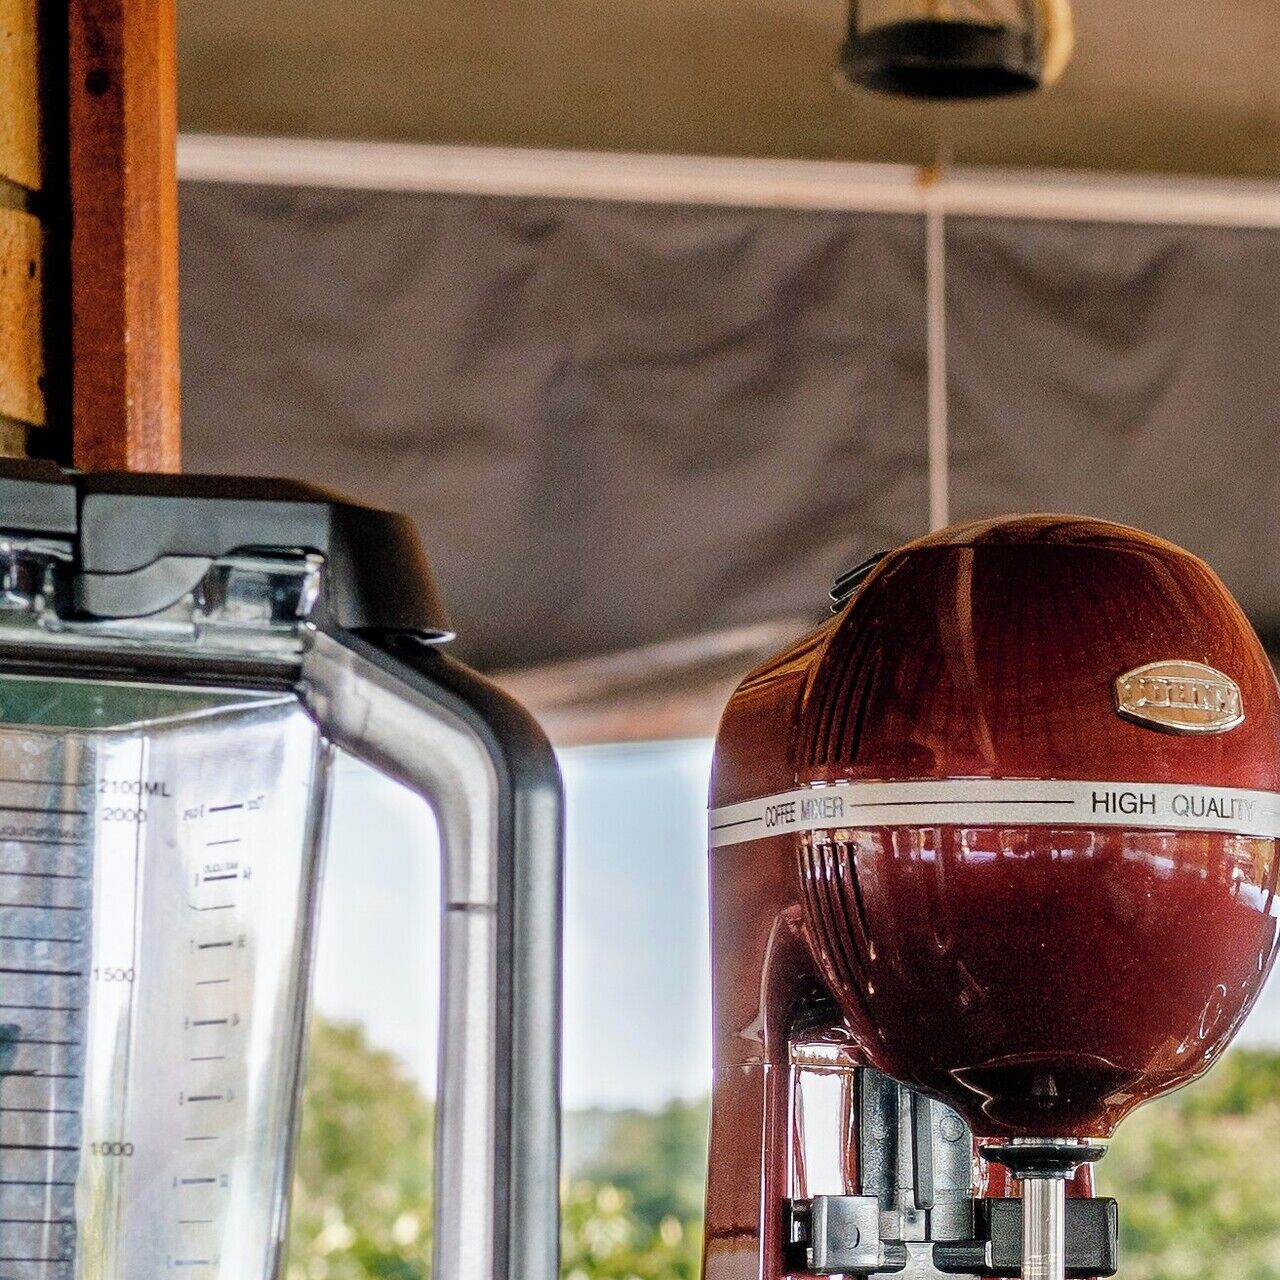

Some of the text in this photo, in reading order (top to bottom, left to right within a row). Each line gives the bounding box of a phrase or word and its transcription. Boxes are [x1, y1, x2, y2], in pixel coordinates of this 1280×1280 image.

[765, 796, 844, 828] COFFEE MIXER
[1091, 791, 1256, 821] HIGH QUALITY
[103, 807, 148, 824] 2000
[93, 967, 135, 983] 1500
[91, 1141, 135, 1158] 1000
